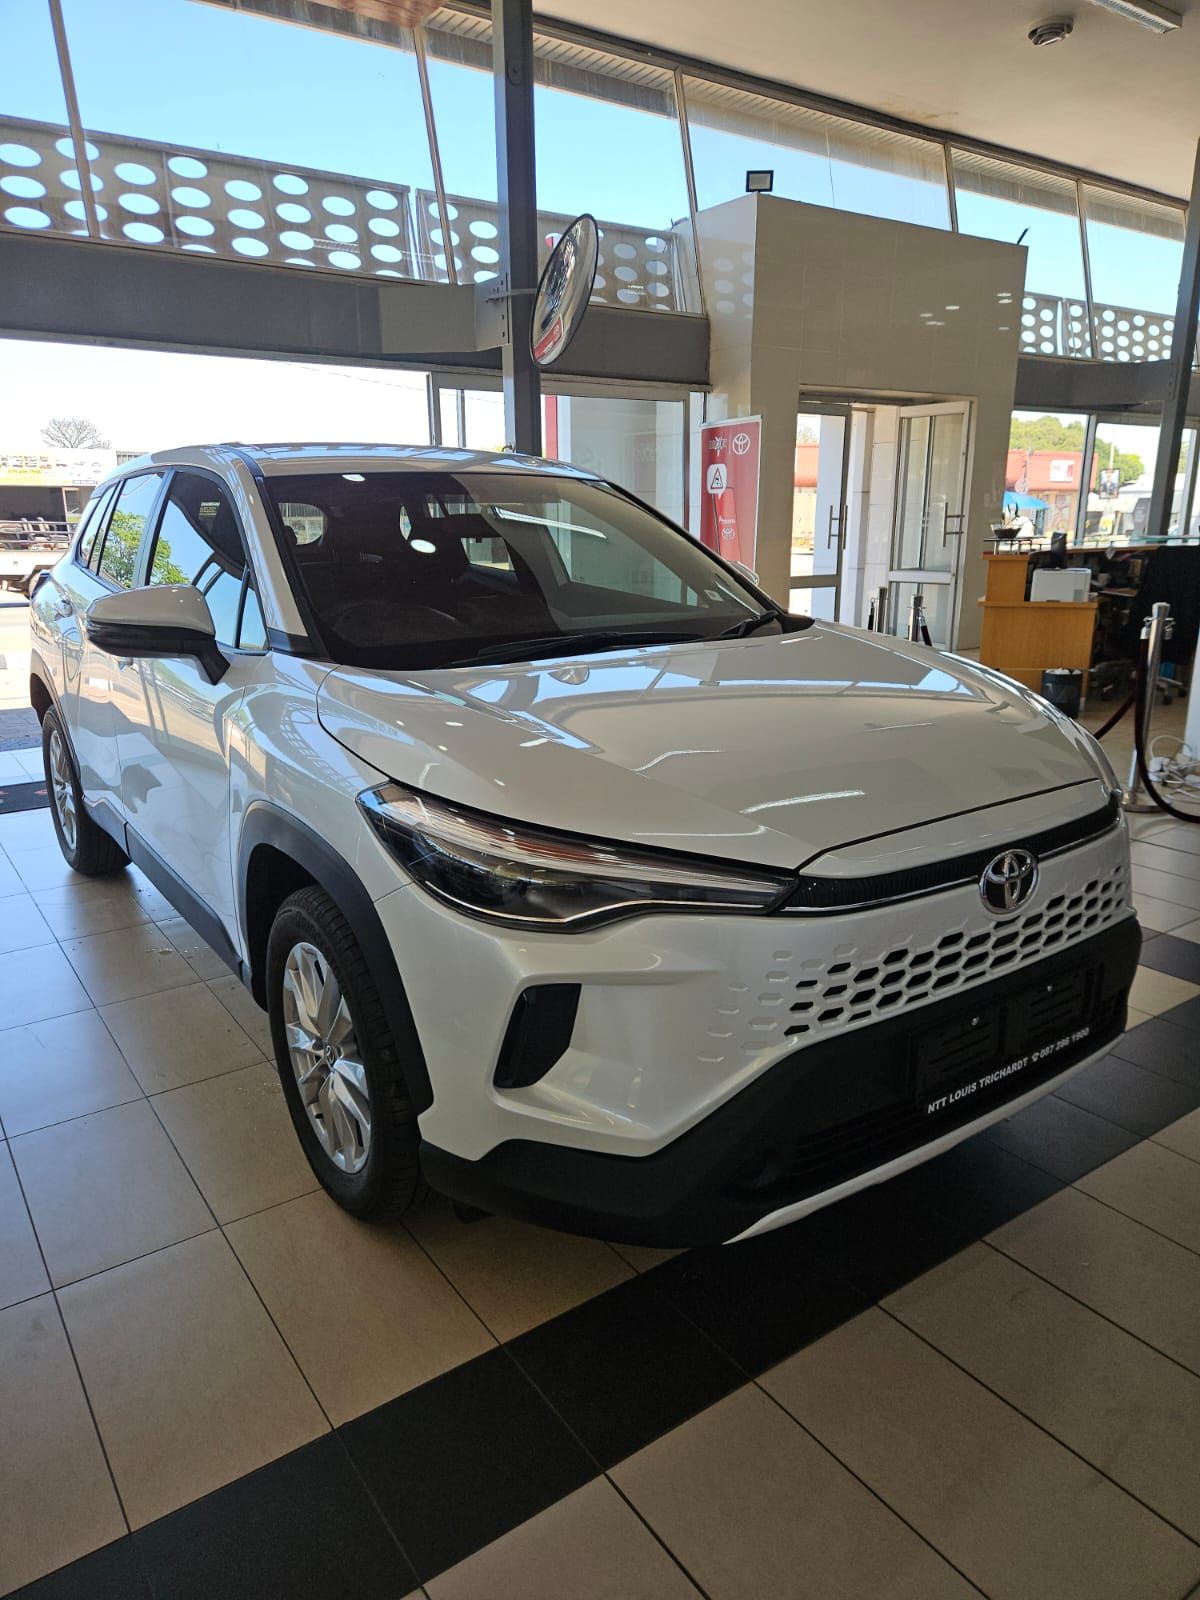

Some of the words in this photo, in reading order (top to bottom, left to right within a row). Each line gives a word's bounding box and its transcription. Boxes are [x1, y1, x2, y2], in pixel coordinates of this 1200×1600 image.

[927, 1096, 947, 1114] NTT
[949, 1082, 977, 1103] LOUIS
[978, 1056, 1028, 1089] TRICHARDT
